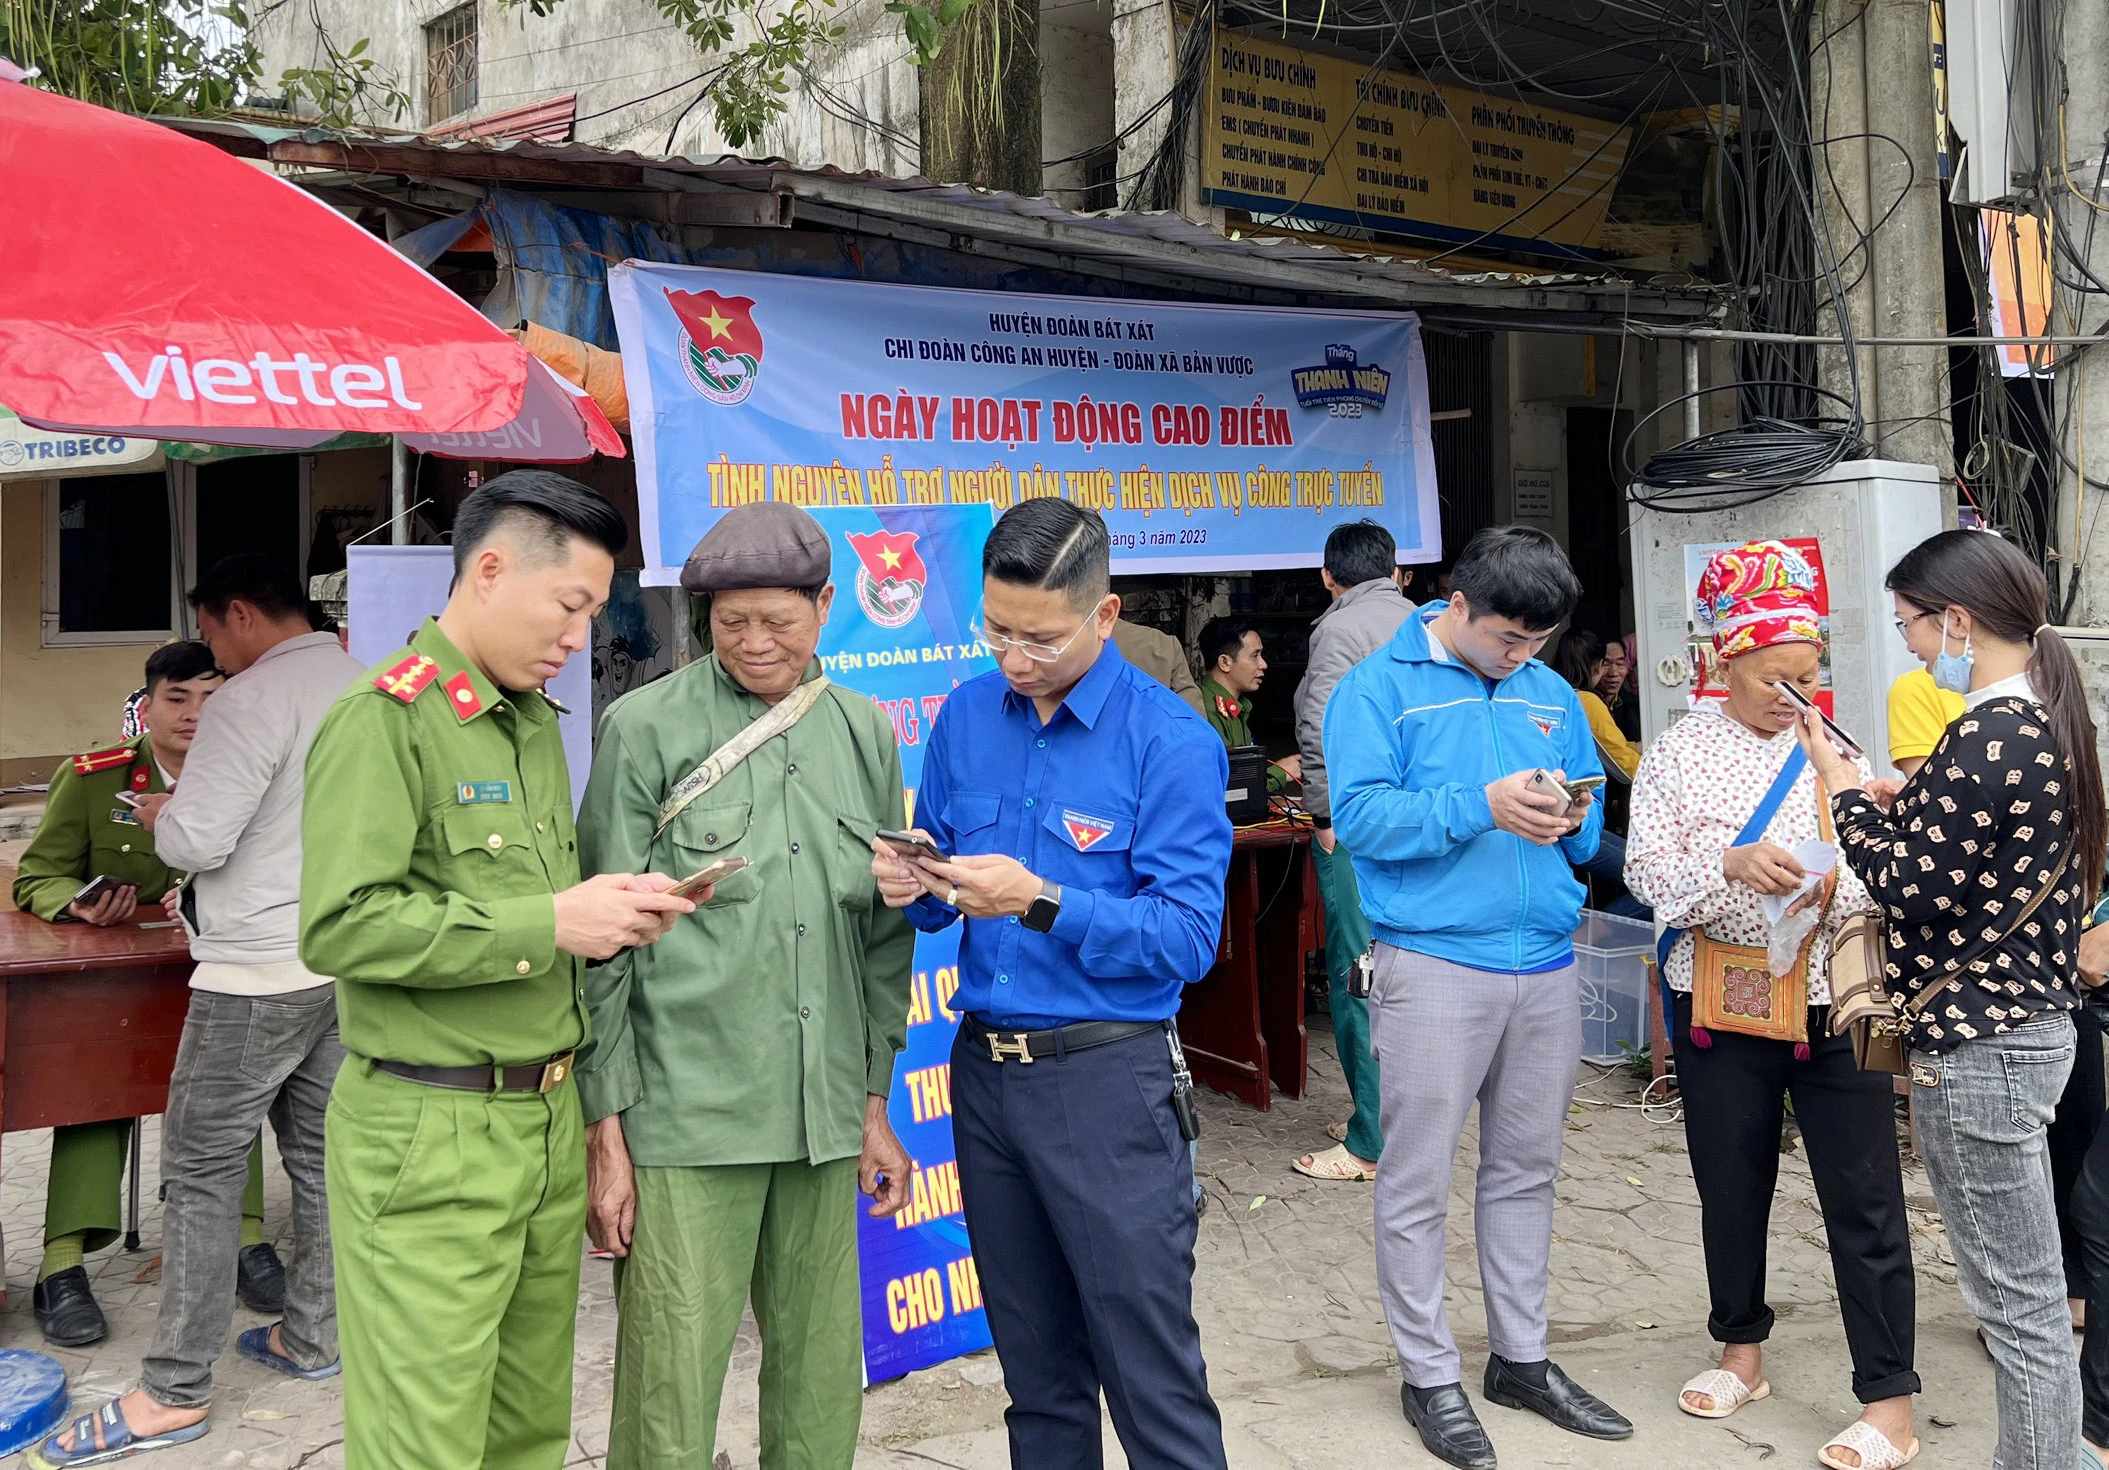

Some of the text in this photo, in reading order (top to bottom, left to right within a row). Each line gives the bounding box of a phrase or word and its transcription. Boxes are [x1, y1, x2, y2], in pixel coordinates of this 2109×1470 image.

[1221, 42, 1246, 78] DỊCH
[1247, 53, 1262, 84] VỤ
[1287, 60, 1316, 90] CHÍNH
[1221, 115, 1237, 132] EMS
[1546, 120, 1575, 146] THÔNG
[1221, 169, 1240, 187] PHÁT
[1240, 172, 1260, 192] HÀNH
[1260, 175, 1274, 194] BÁO
[989, 313, 1156, 341] HUYỆN ĐOÀN BÁT XÁT
[884, 337, 914, 361] CHI
[918, 338, 966, 363] ĐOÀN
[969, 339, 1016, 366] CÔNG
[1020, 346, 1043, 367] AN
[1047, 347, 1100, 374] HUYỆN
[1113, 350, 1156, 372] ĐOÀN
[1158, 352, 1180, 373] XÃ
[1183, 350, 1214, 375] BẢN
[1216, 355, 1255, 379] VƯỢC
[1326, 345, 1355, 361] Tháng
[102, 346, 423, 411] viettel
[1295, 367, 1389, 395] THANH NIÊN
[839, 387, 1296, 452] NGÀY HOẠT ĐỘNG CAO ĐIỂM
[1327, 403, 1363, 418] 2023
[25, 437, 125, 460] TRIBECO
[706, 454, 765, 508] TÌNH
[865, 453, 898, 505] HỖ
[1018, 462, 1061, 503] DÂN
[1119, 464, 1166, 518] HIỆN
[1168, 471, 1216, 517] DỊCH
[1215, 471, 1243, 517] VỤ
[1245, 464, 1292, 508] CÔNG
[1294, 467, 1335, 515] TRỰC
[1337, 460, 1385, 507] TUYẾN
[1139, 530, 1147, 546] 3
[1150, 530, 1177, 545] năm
[1179, 529, 1208, 545] 2023
[820, 639, 992, 673] UYỆN ĐOÀN BÁT XÁT
[886, 1267, 945, 1335] CHO
